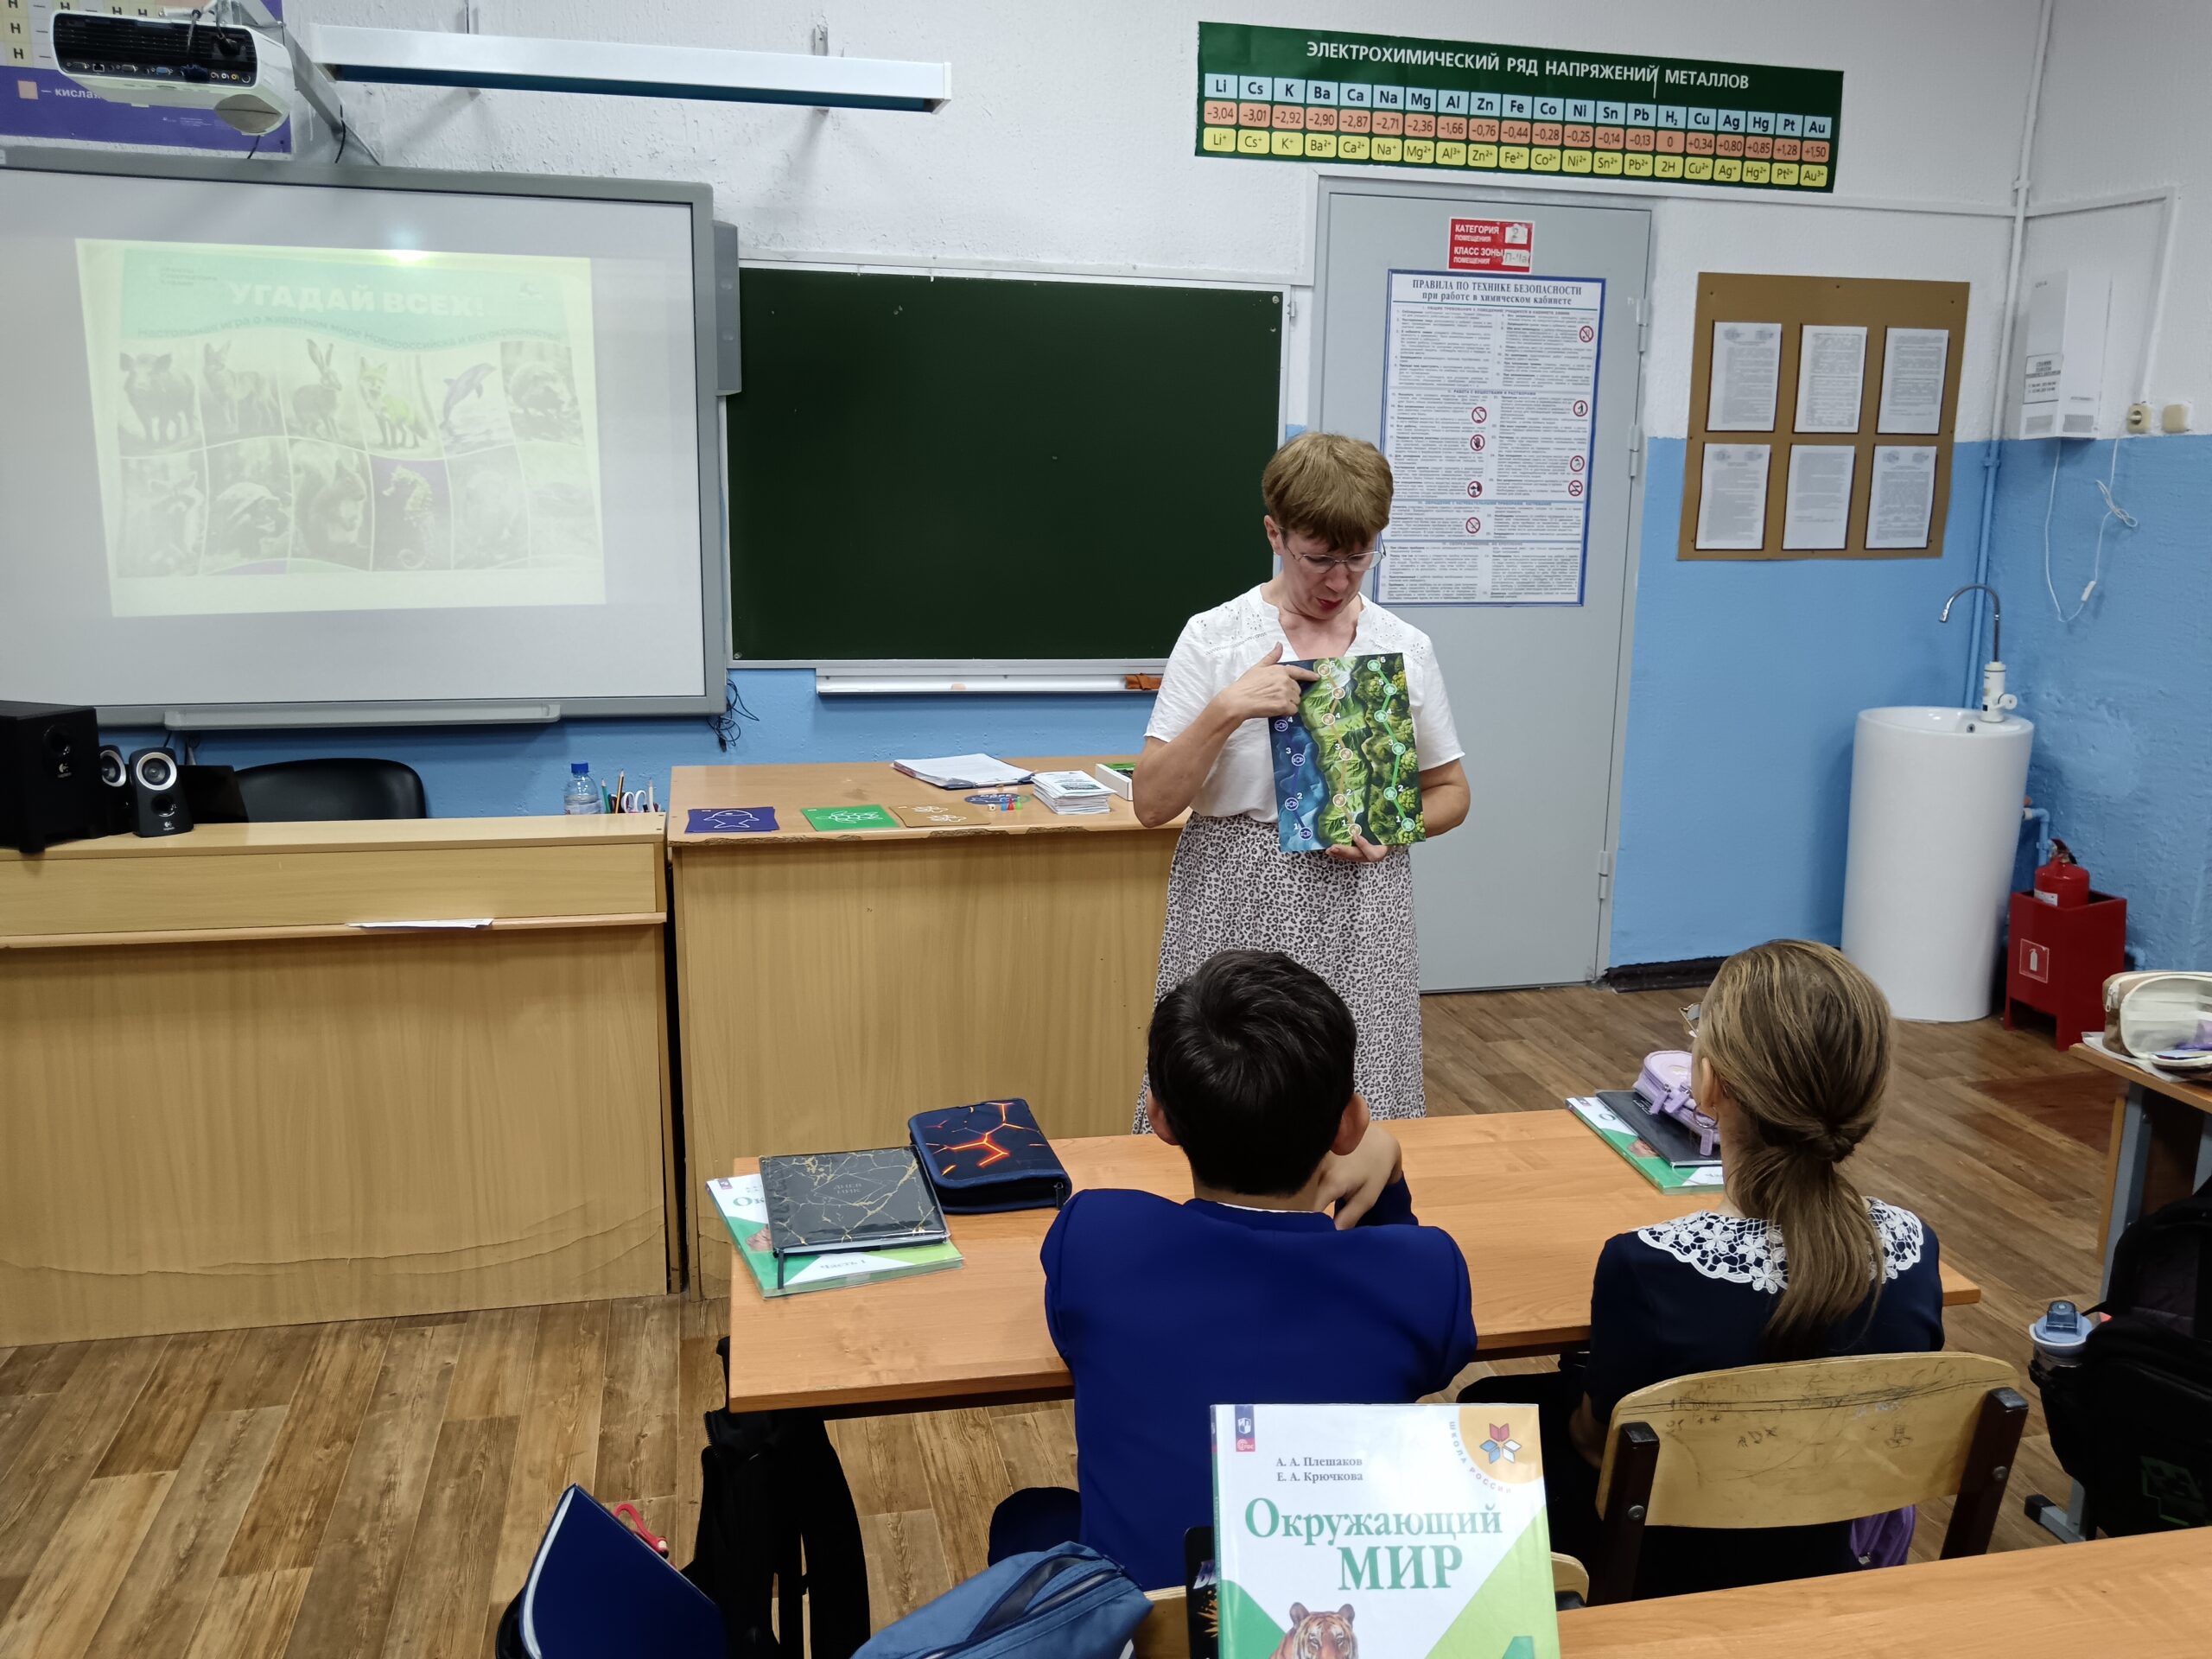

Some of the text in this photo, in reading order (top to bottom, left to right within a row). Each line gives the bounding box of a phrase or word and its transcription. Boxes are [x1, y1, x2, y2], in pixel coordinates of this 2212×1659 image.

[1306, 41, 1749, 89] ЭЛЕКТРОХИМИЧЕСКИЙ РЯД НАПРЯЖЕНИЙ МЕТАЛЛОВ
[1215, 79, 1227, 93] Li
[1248, 82, 1263, 95] Cs
[1285, 84, 1294, 98] K
[1314, 86, 1331, 100] Ba
[1347, 89, 1364, 102] Ca
[1379, 91, 1398, 104] Na
[1410, 92, 1431, 109] Mg
[1446, 94, 1461, 109] Al
[1477, 98, 1494, 111] Zn
[1510, 99, 1524, 114] Fe
[1540, 102, 1557, 116] Co
[1573, 105, 1586, 118] Ni
[1603, 106, 1618, 119] Sn
[1634, 108, 1649, 122] Pb
[1694, 113, 1710, 126] Cu
[1723, 115, 1740, 131] Ag
[1752, 118, 1770, 132] Hg
[1783, 118, 1796, 131] Pt
[1808, 120, 1826, 133] Au
[1455, 225, 1500, 235] КАТЕГОРИЯ
[1453, 246, 1479, 256] КЛАСС
[1480, 248, 1504, 257] ЗОНЫ
[1413, 279, 1582, 296] ПРАВИЛА ПО ТЕХНИКЕ БЕЗОПАСНОСТИ
[1440, 292, 1470, 302] работе
[1480, 294, 1531, 303] химическом
[1534, 294, 1572, 305] кабинете
[228, 282, 485, 318] УГАДАЙ ВСЕХ!
[138, 323, 219, 339] Настольная
[221, 316, 251, 330] игра
[265, 316, 327, 330] животном
[1449, 1421, 1467, 1464] ШКОЛА
[1276, 1457, 1363, 1467] А. А. Плешаков
[1277, 1471, 1363, 1484] Е. А. Крючкова
[1245, 1497, 1503, 1547] Окружающий
[1338, 1544, 1463, 1591] МИР
